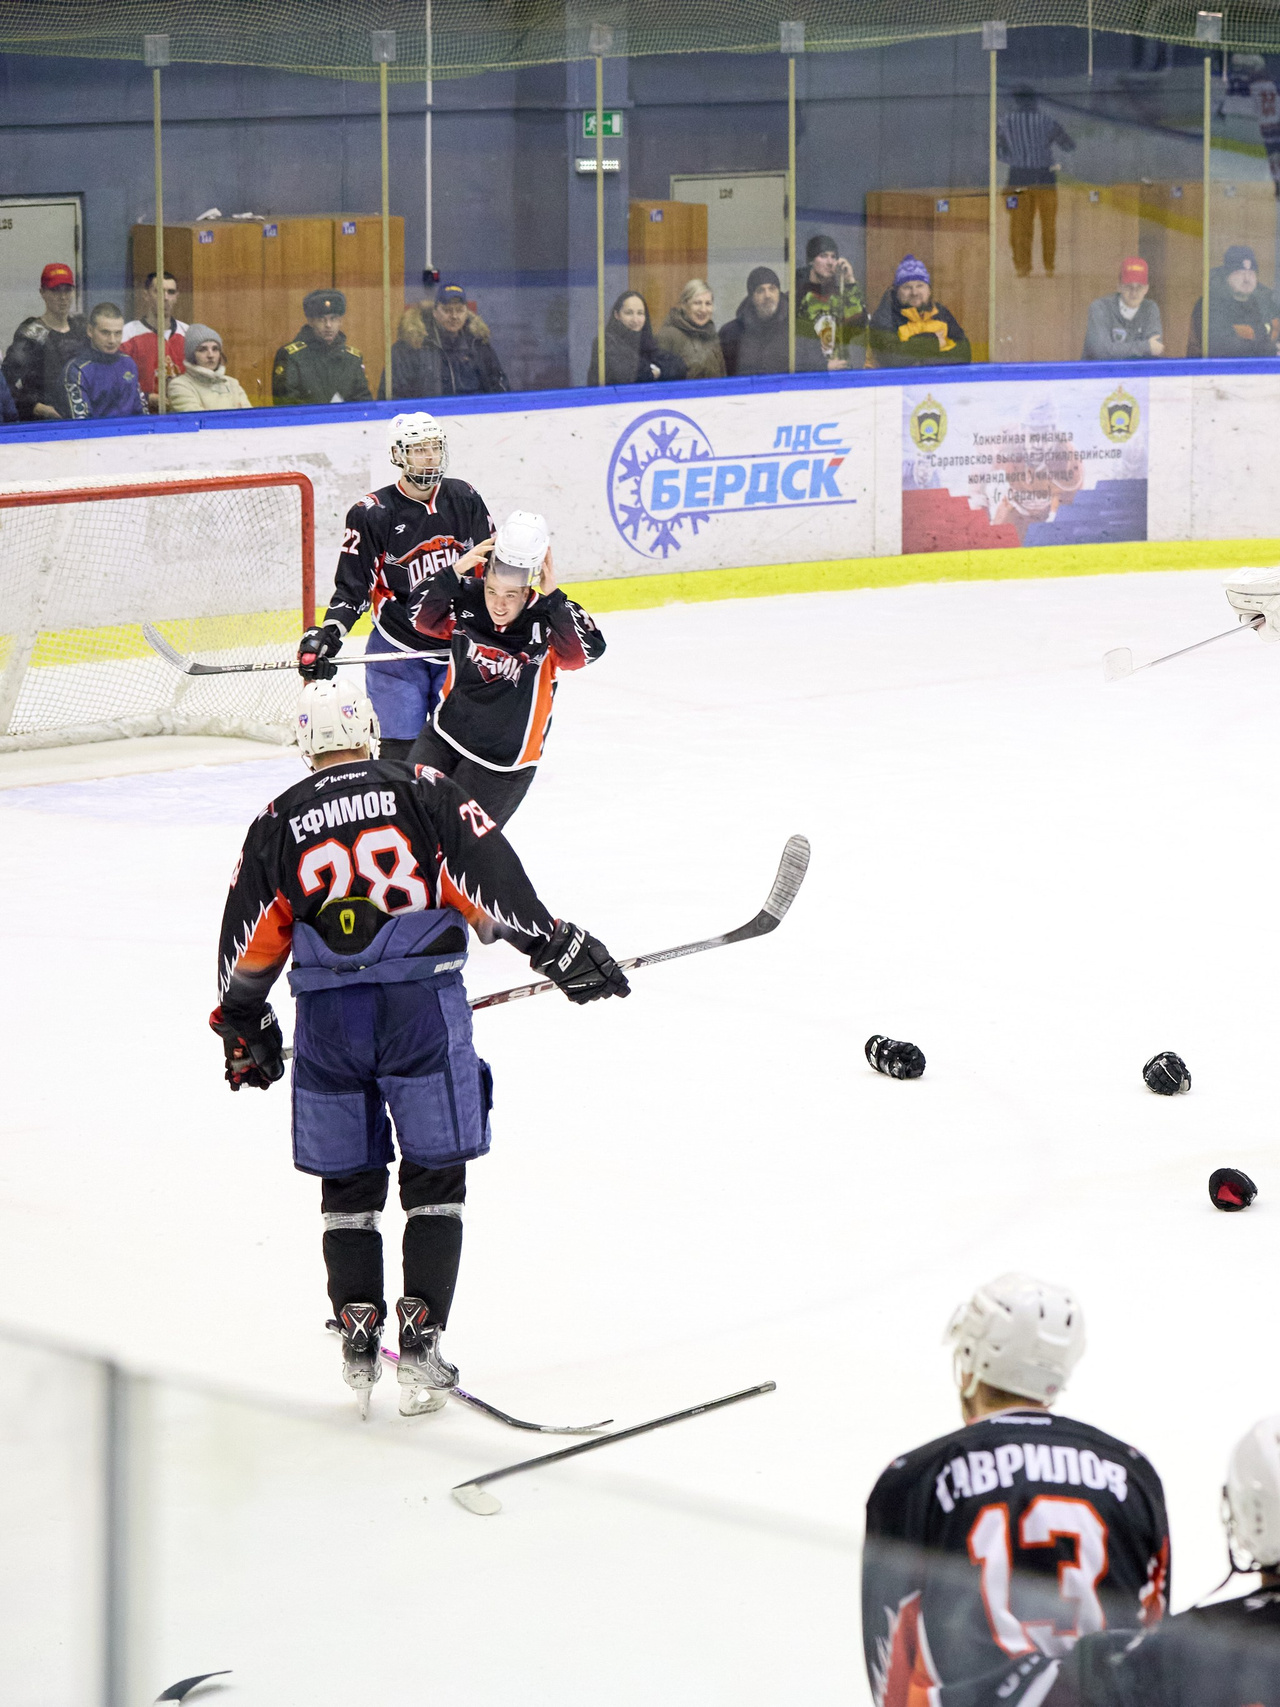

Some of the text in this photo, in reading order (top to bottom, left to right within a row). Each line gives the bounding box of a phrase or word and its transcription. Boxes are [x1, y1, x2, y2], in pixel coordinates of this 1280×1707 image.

[773, 422, 844, 451] ЛДС
[972, 430, 1074, 446] Хоккейная команда
[926, 453, 993, 470] "Саратовское
[650, 457, 846, 512] БЕРДСК
[341, 528, 361, 556] 22
[529, 621, 542, 645] A
[252, 660, 300, 671] BAUE
[330, 770, 368, 785] keeper
[288, 790, 398, 845] ЕФИМОВ
[297, 825, 430, 917] 28
[935, 1442, 1129, 1514] ГАВРИЛОВ
[968, 1495, 1109, 1660] 13
